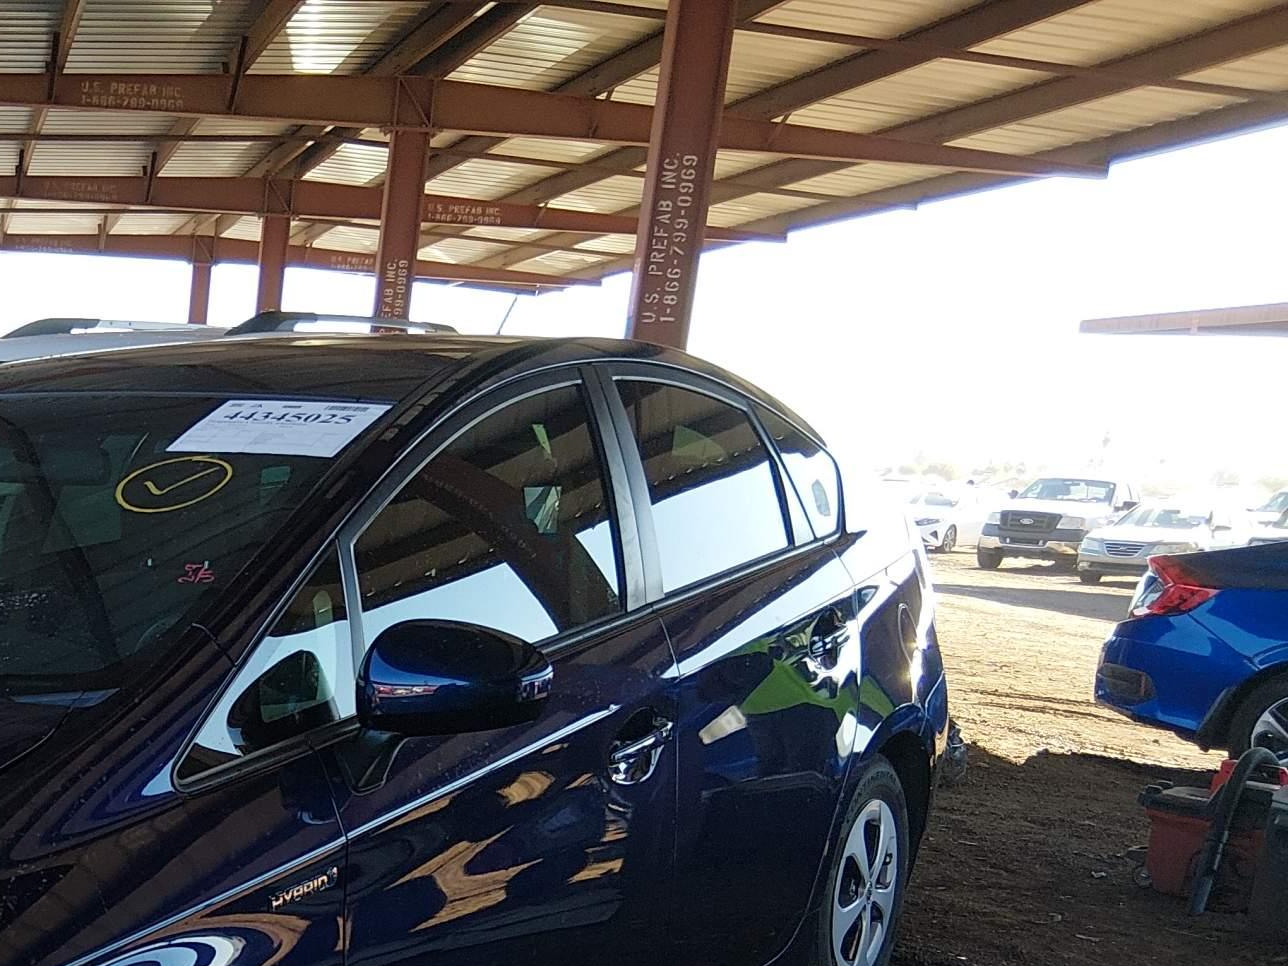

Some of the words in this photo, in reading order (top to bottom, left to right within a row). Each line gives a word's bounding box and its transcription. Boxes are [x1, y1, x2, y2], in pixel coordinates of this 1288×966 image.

[647, 199, 673, 276] PREFAB
[661, 152, 681, 189] INC.
[659, 154, 699, 322] 1-866-799-0969
[223, 409, 357, 426] 44345025
